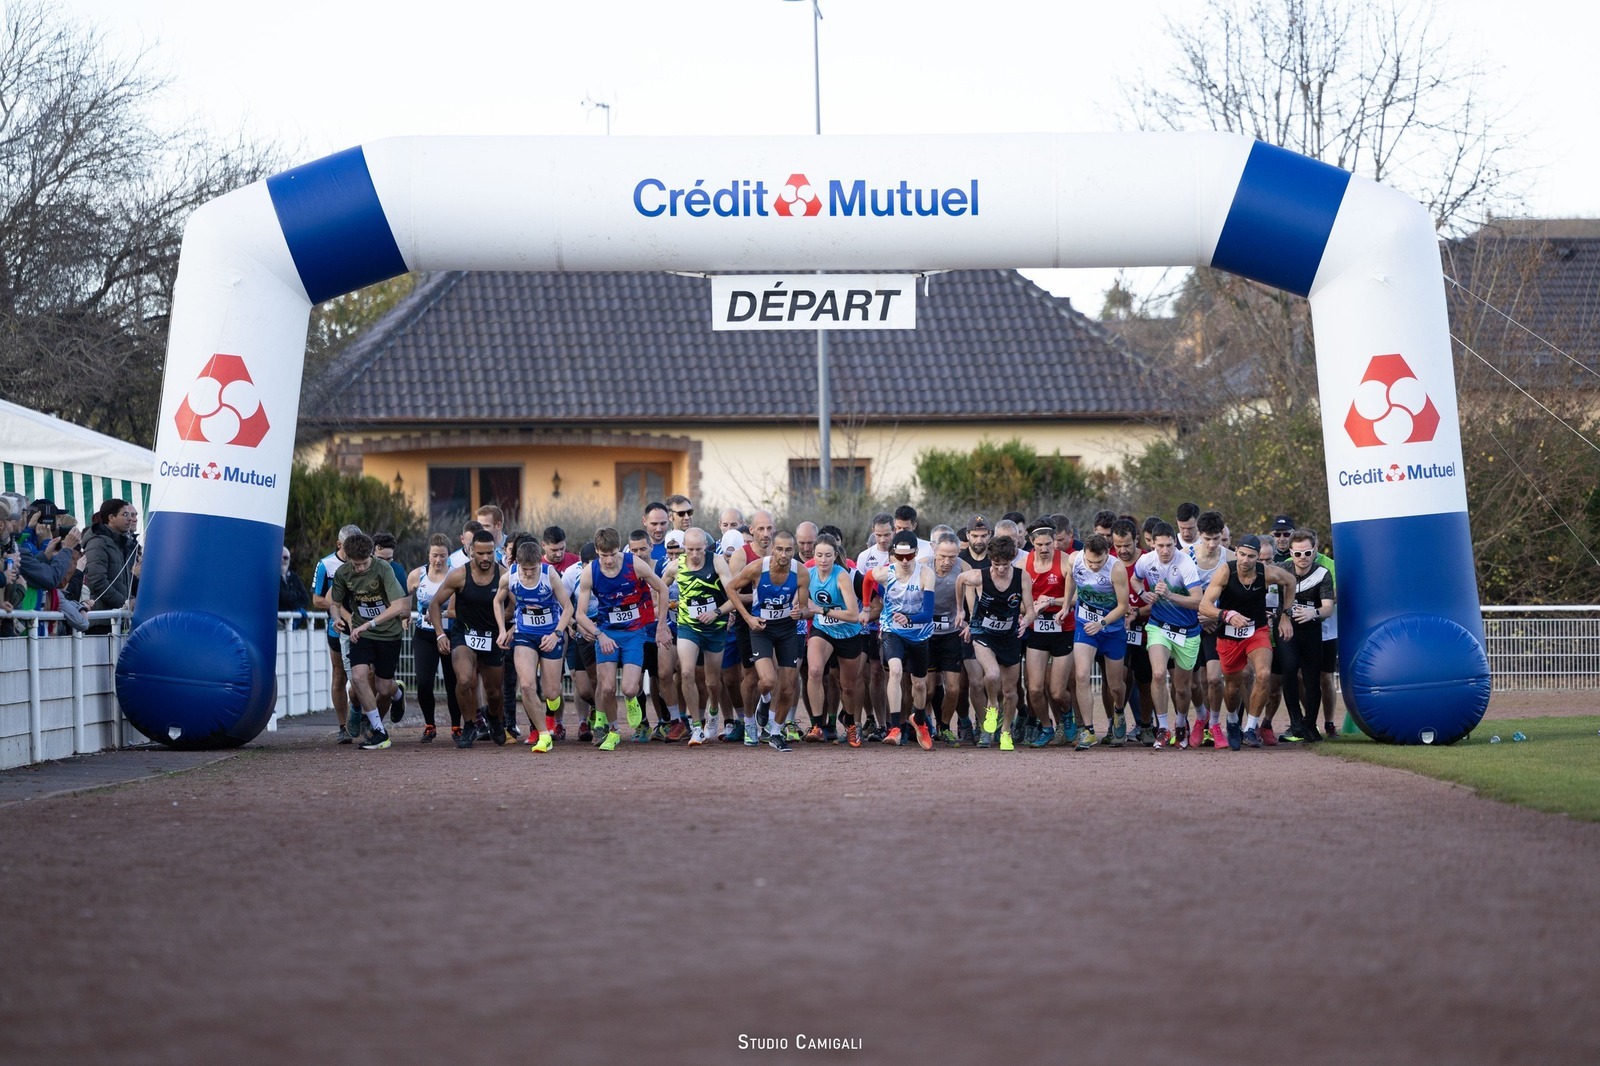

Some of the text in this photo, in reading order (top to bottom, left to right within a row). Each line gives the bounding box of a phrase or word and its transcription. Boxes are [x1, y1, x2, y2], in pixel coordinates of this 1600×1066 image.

[633, 178, 979, 218] Crédit Mutuel
[726, 281, 902, 322] DÉPART
[160, 461, 277, 488] Crédit Mutuel
[1339, 461, 1456, 486] Crédit Mutuel
[365, 607, 381, 617] 190
[616, 611, 633, 621] 329
[769, 609, 785, 619] 127
[1084, 610, 1099, 623] 198
[530, 616, 546, 625] 103
[989, 620, 1007, 630] 447
[1038, 620, 1056, 631] 254
[1233, 627, 1249, 637] 182
[470, 637, 486, 649] 372
